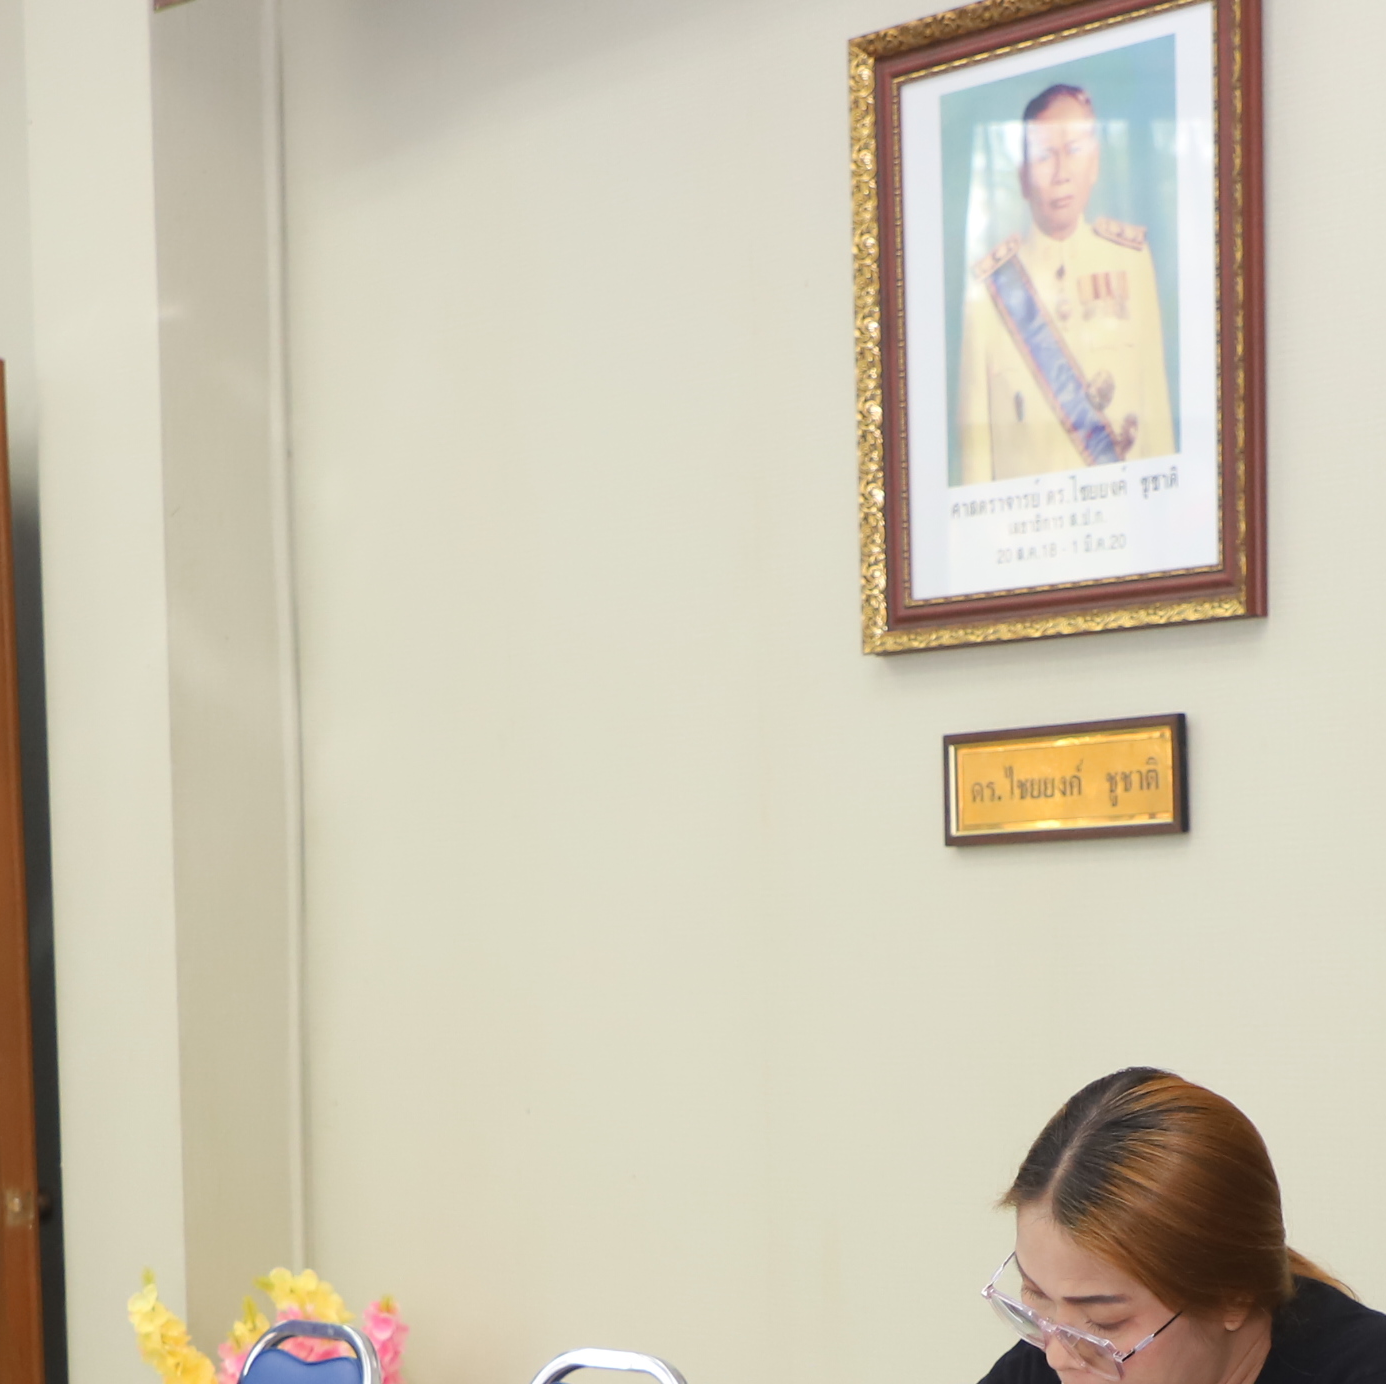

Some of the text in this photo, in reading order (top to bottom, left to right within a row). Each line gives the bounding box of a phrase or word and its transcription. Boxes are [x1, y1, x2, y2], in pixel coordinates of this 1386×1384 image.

[1140, 466, 1180, 498] ชูชาติ
[971, 757, 1160, 807] ดร.ไชยยงค์ ชูชาติ
